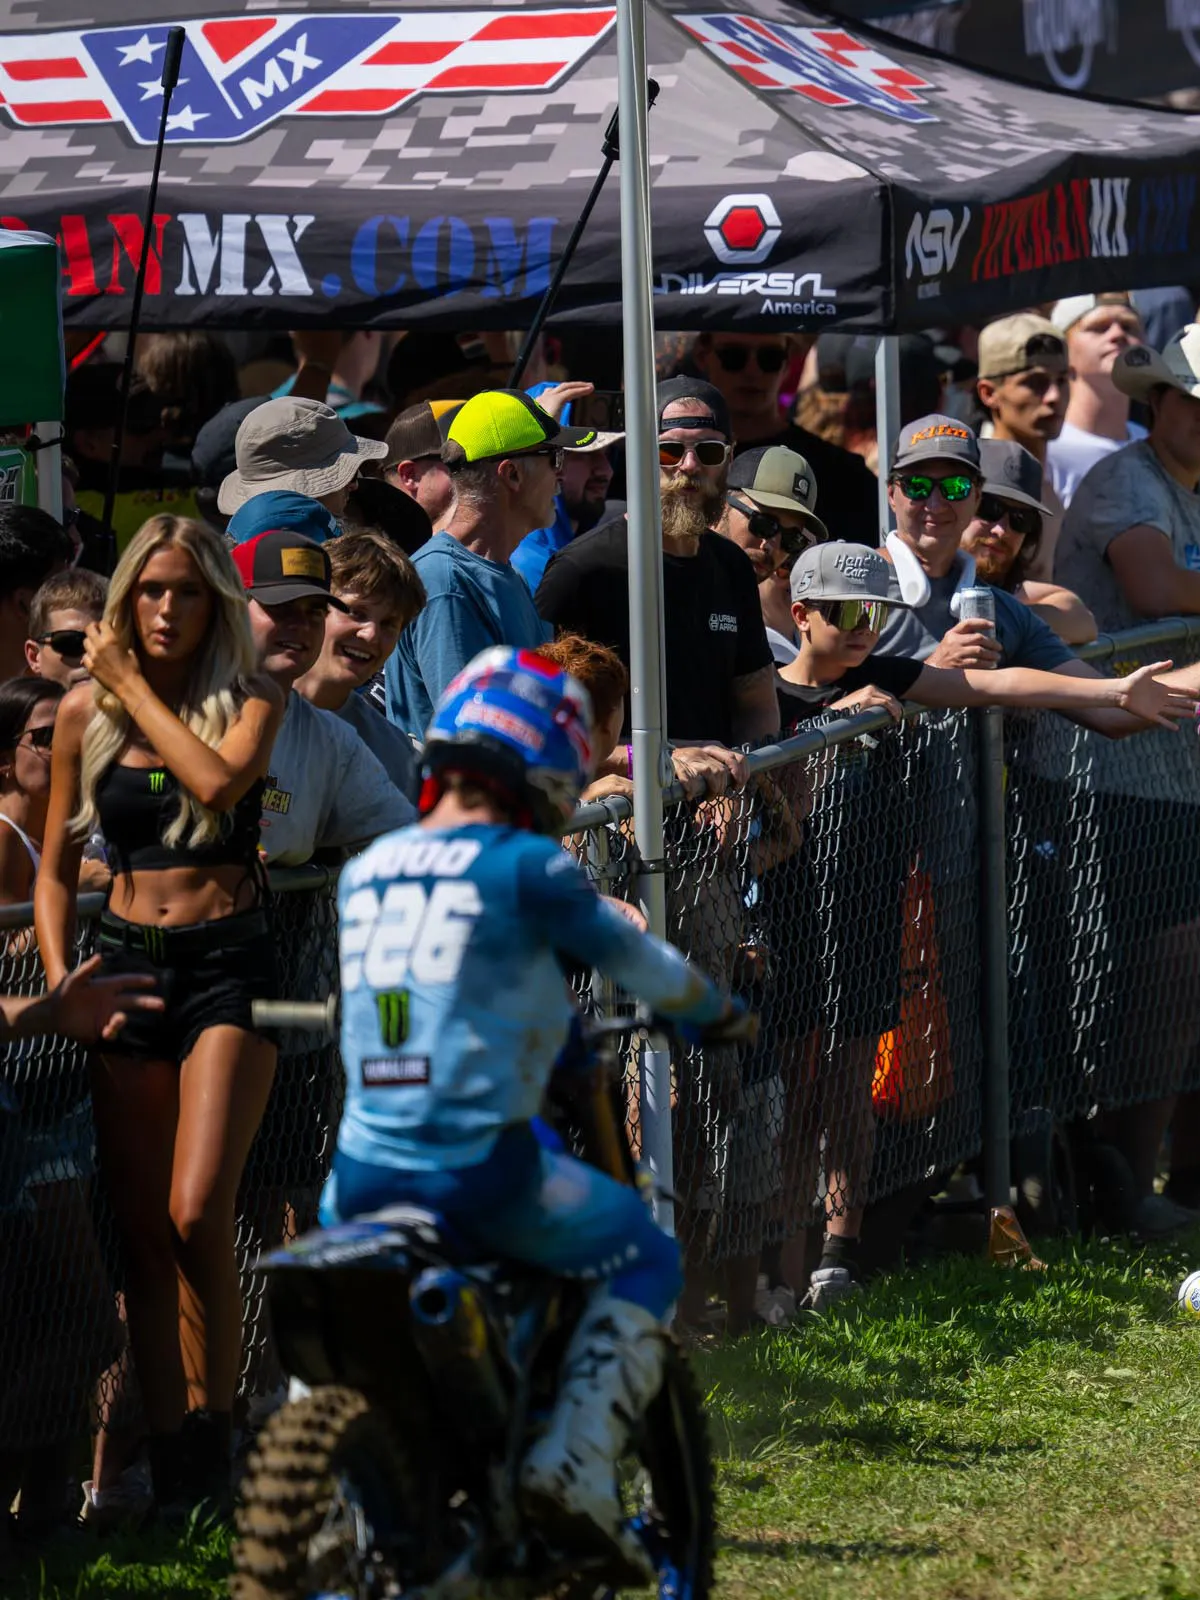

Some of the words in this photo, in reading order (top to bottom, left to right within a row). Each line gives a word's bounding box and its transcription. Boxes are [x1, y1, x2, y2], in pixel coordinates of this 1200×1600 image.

[239, 33, 323, 111] MX
[760, 299, 837, 315] America
[796, 569, 815, 594] 5
[341, 879, 484, 992] 226
